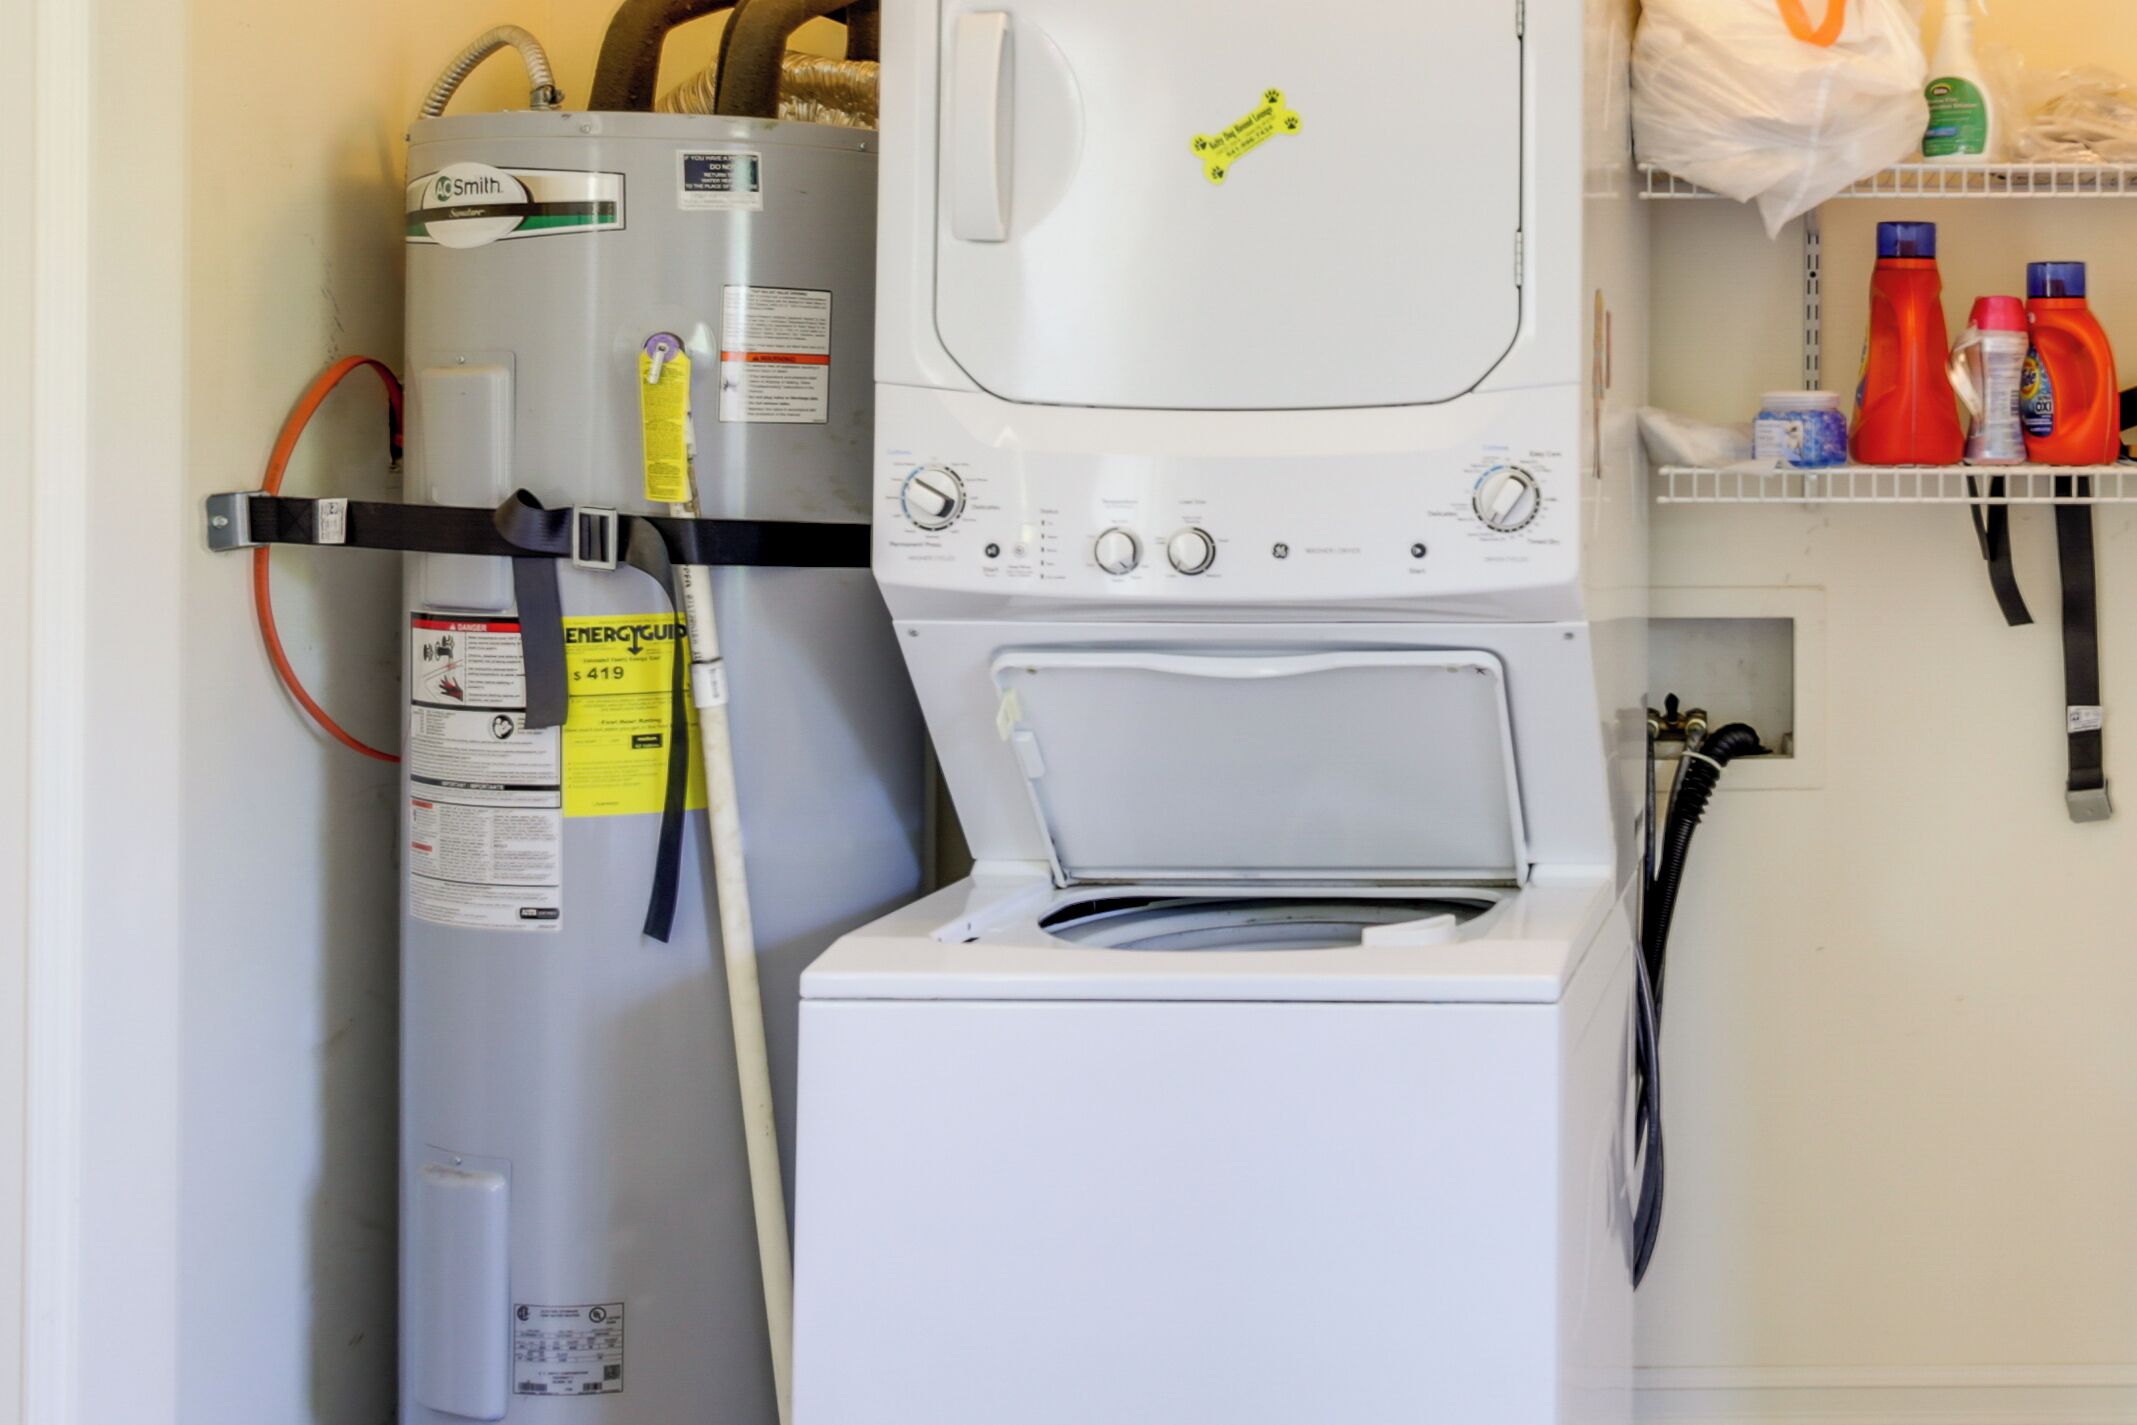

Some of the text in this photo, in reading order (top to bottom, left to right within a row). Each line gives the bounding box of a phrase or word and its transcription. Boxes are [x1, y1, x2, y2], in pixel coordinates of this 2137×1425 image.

[454, 177, 501, 196] Smith
[2035, 401, 2052, 412] OXI
[457, 624, 488, 632] DANGER
[565, 624, 687, 644] ENERGYGUID
[574, 666, 624, 681] $ 419
